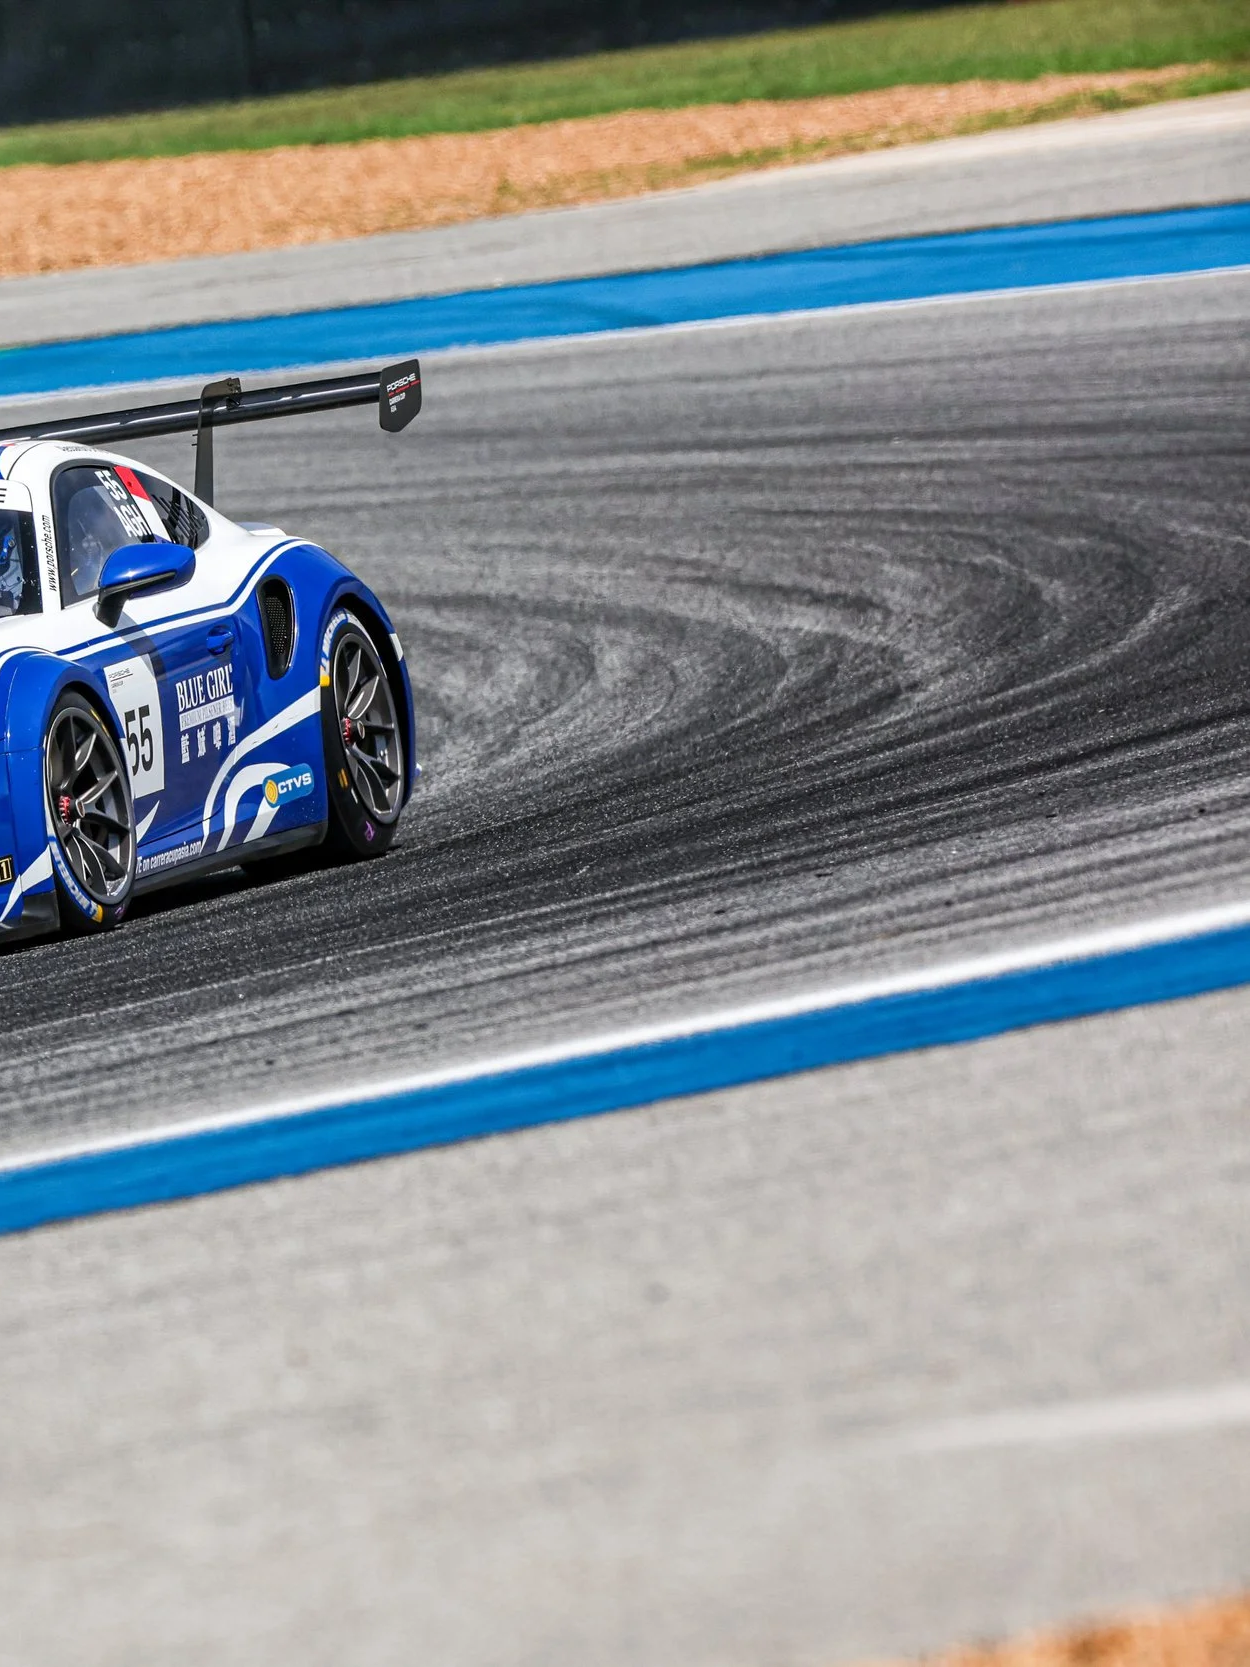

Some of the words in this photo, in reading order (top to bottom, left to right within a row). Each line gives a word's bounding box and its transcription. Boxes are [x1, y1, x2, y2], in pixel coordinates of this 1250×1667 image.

[94, 470, 128, 501] 55
[113, 504, 152, 538] AGH
[41, 515, 58, 592] www.porsche.com
[175, 674, 206, 712] BLUE
[206, 664, 234, 700] GIRL
[124, 705, 153, 776] 55
[277, 772, 312, 794] CTVS
